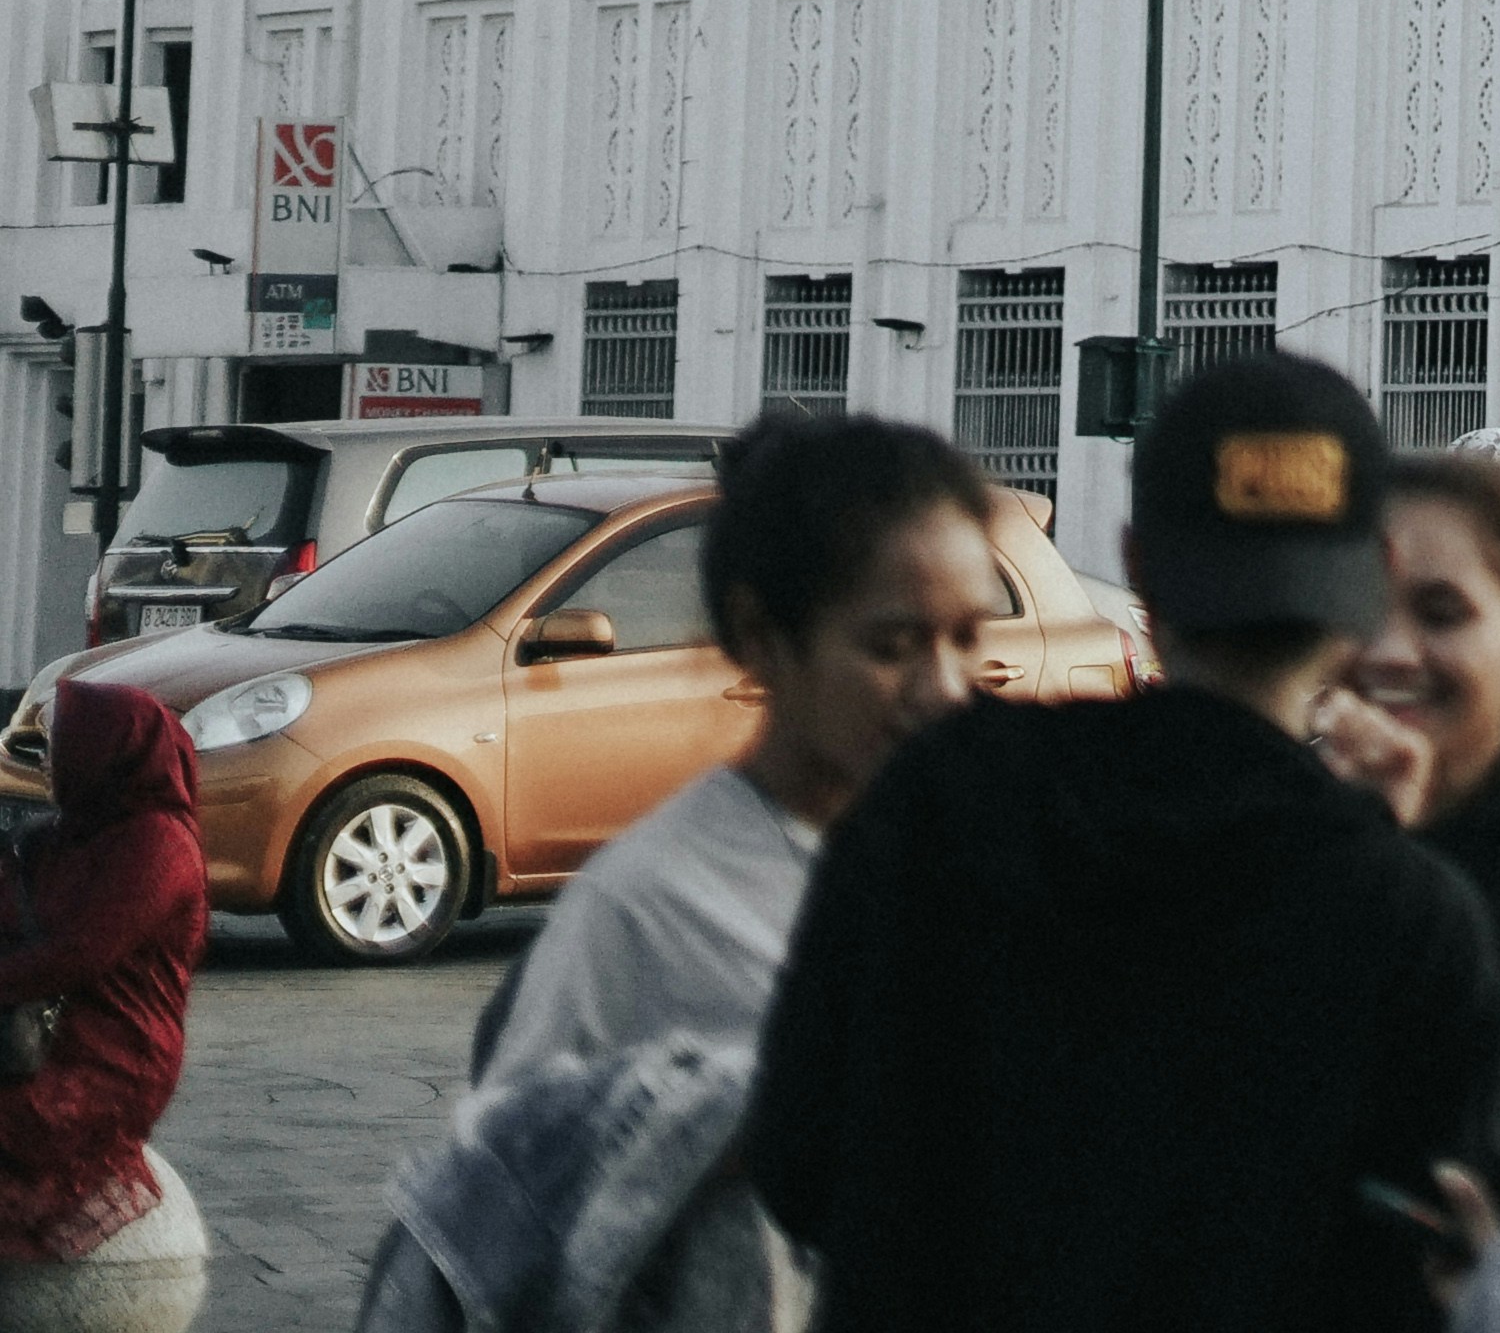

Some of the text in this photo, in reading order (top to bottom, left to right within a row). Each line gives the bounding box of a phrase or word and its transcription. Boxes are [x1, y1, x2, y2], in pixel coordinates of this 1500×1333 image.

[271, 193, 332, 223] BNI
[265, 283, 304, 300] ATM
[396, 367, 449, 393] BNI
